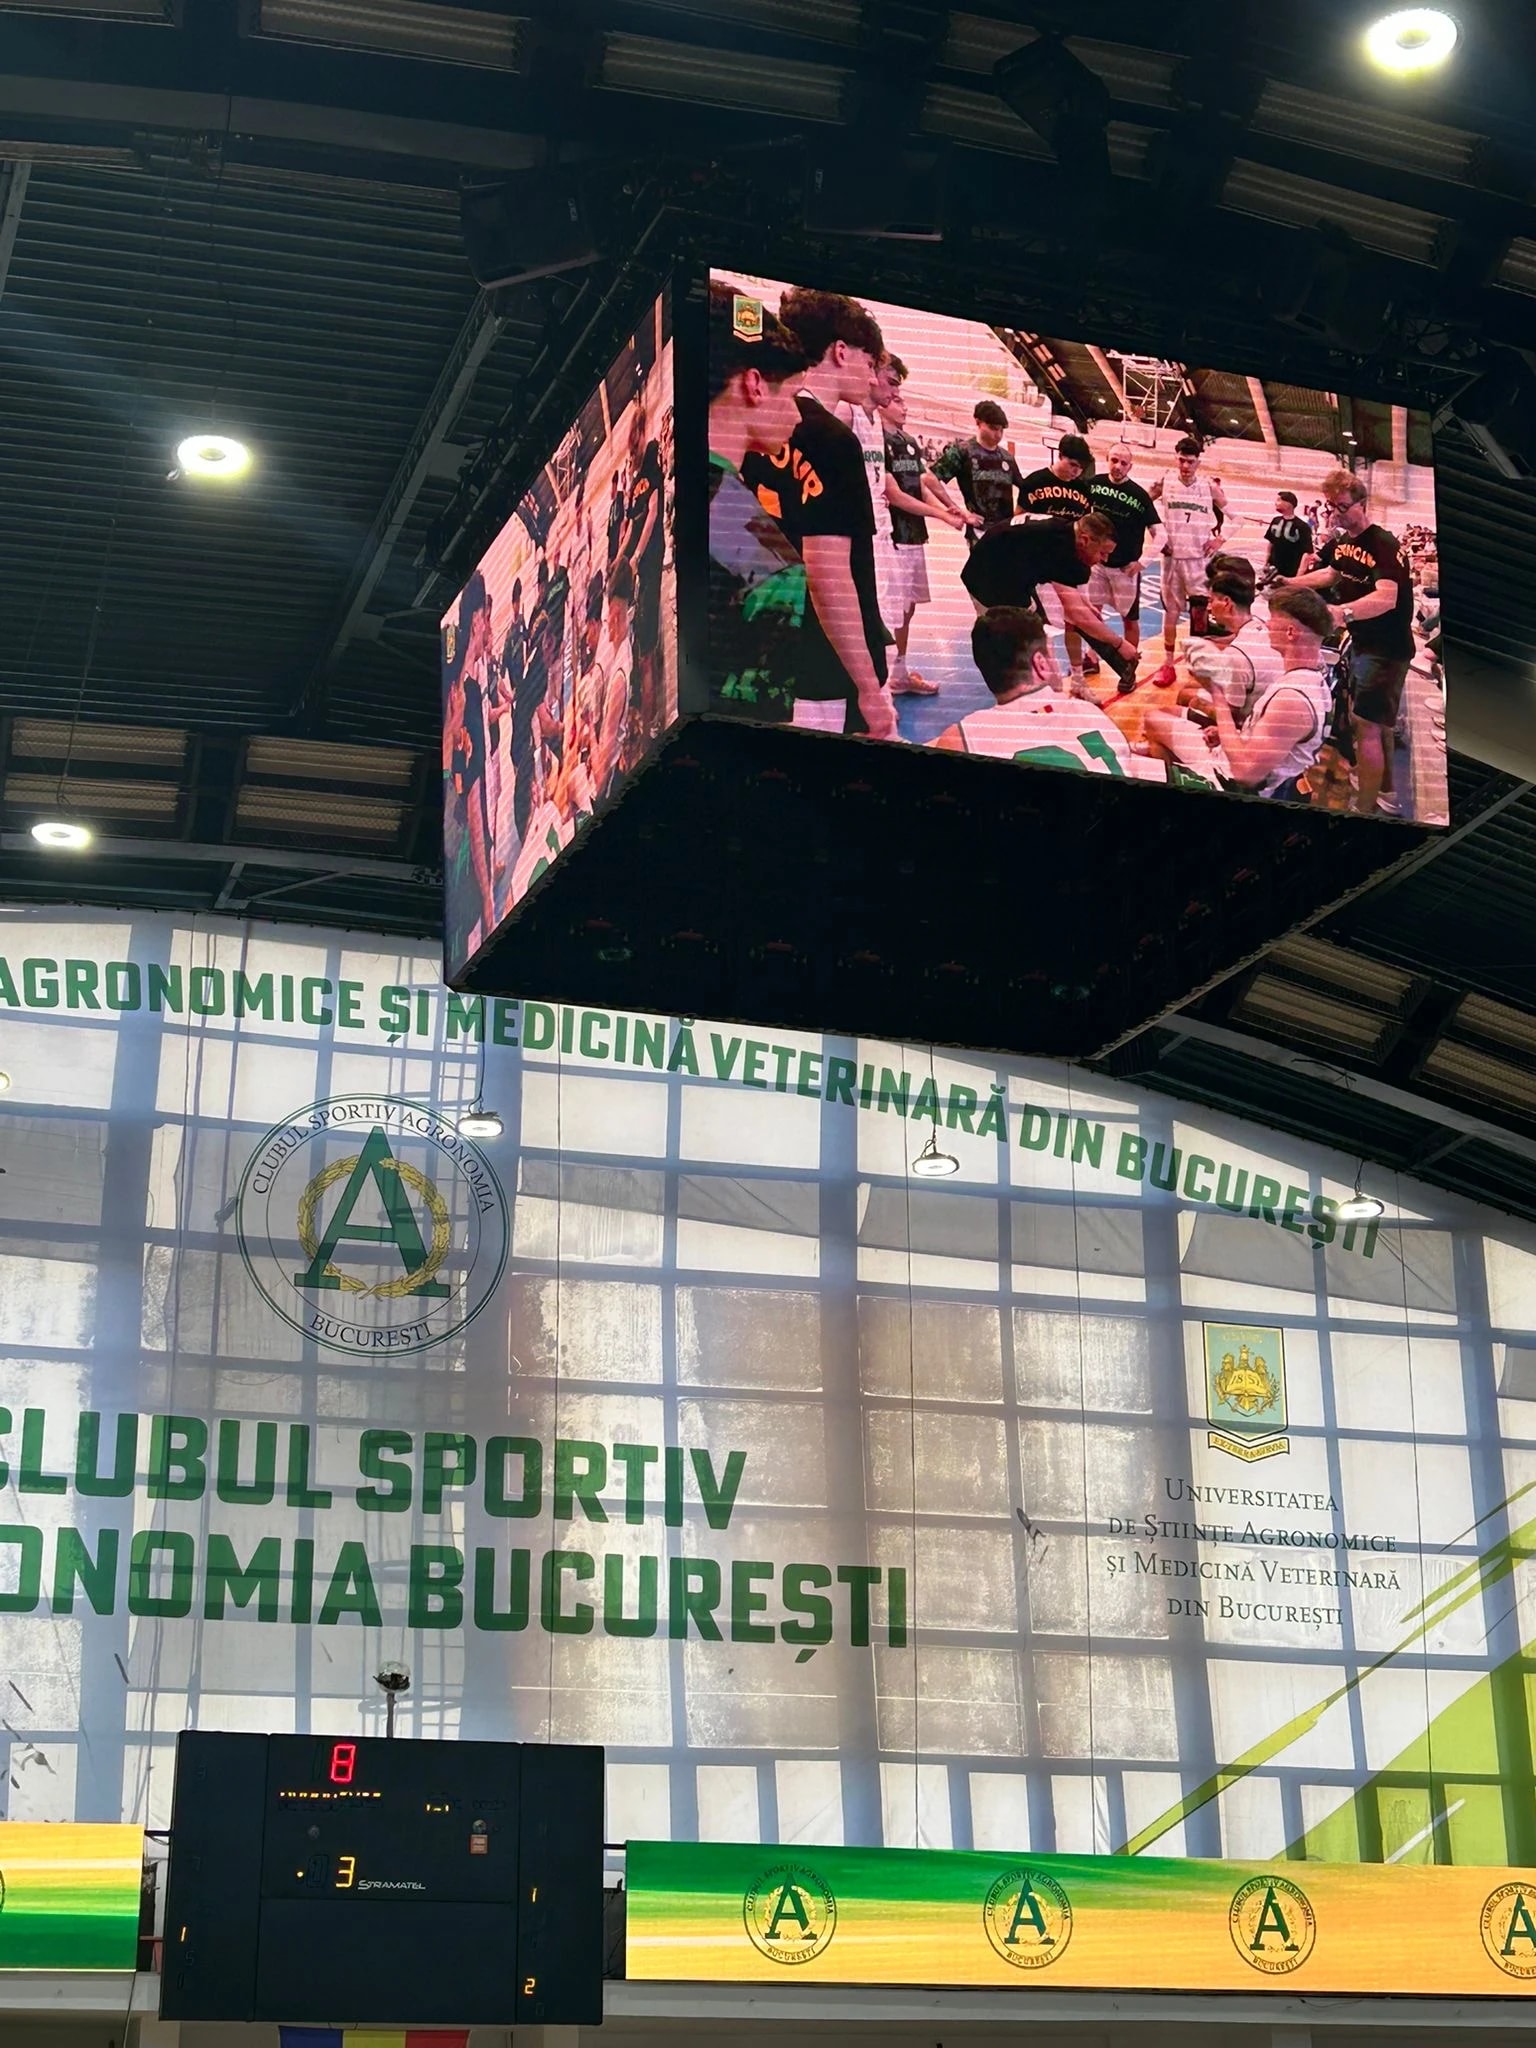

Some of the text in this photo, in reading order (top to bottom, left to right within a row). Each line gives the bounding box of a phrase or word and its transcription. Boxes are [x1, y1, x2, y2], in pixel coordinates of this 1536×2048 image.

[1184, 512, 1191, 523] 7
[0, 957, 365, 1029] AGRONOMICE
[379, 986, 429, 1043] ȘI
[446, 992, 700, 1076] MEDICINĂ
[710, 1033, 1008, 1143] VETERINARĂ
[1019, 1103, 1106, 1169] DIN
[252, 1103, 495, 1214] CLUBUL SPORTIV AGRONOMIA
[294, 1126, 450, 1298] A
[309, 1313, 433, 1348] BUCUREȘTI
[0, 1407, 747, 1530] LUBUL SPORTIV
[1164, 1478, 1339, 1512] UNIVERSITATEA
[1109, 1517, 1137, 1535] DE
[1240, 1521, 1397, 1552] AGRONOMICE
[1106, 1552, 1401, 1590] ȘI MEDICINĂ VETERINARĂ
[408, 1544, 908, 1663] BUCUREȘTI
[1167, 1595, 1343, 1631] DIN BUCUREȘTI
[330, 1743, 357, 1783] 8
[335, 1856, 356, 1888] 3
[357, 1879, 426, 1890] STRAMATEL
[524, 1977, 536, 1994] 2
